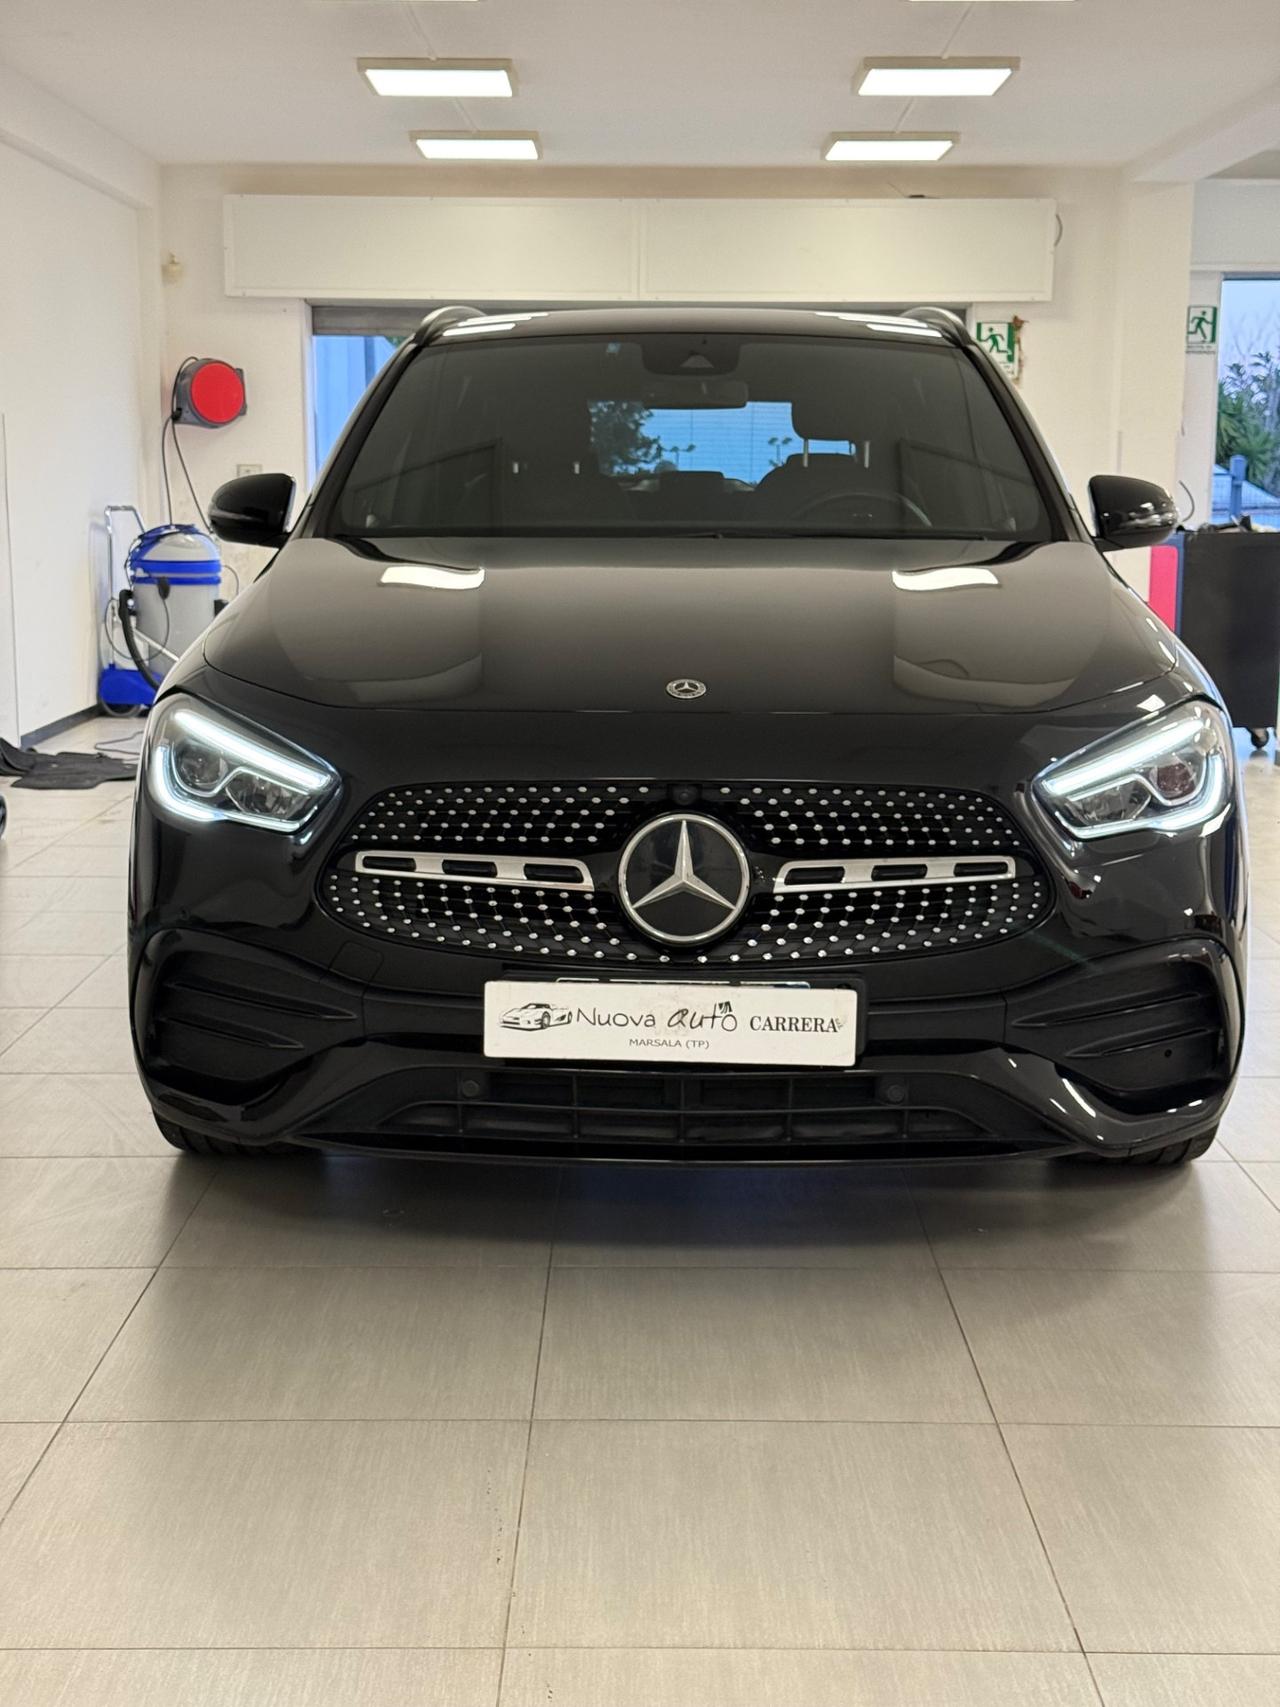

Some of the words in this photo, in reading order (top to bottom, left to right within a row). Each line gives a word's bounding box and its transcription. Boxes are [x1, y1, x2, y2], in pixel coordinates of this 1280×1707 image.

[576, 1007, 656, 1028] Nuova
[750, 1015, 838, 1033] CARRERA
[628, 1038, 682, 1048] MARSALA
[685, 1039, 710, 1050] (TP)
